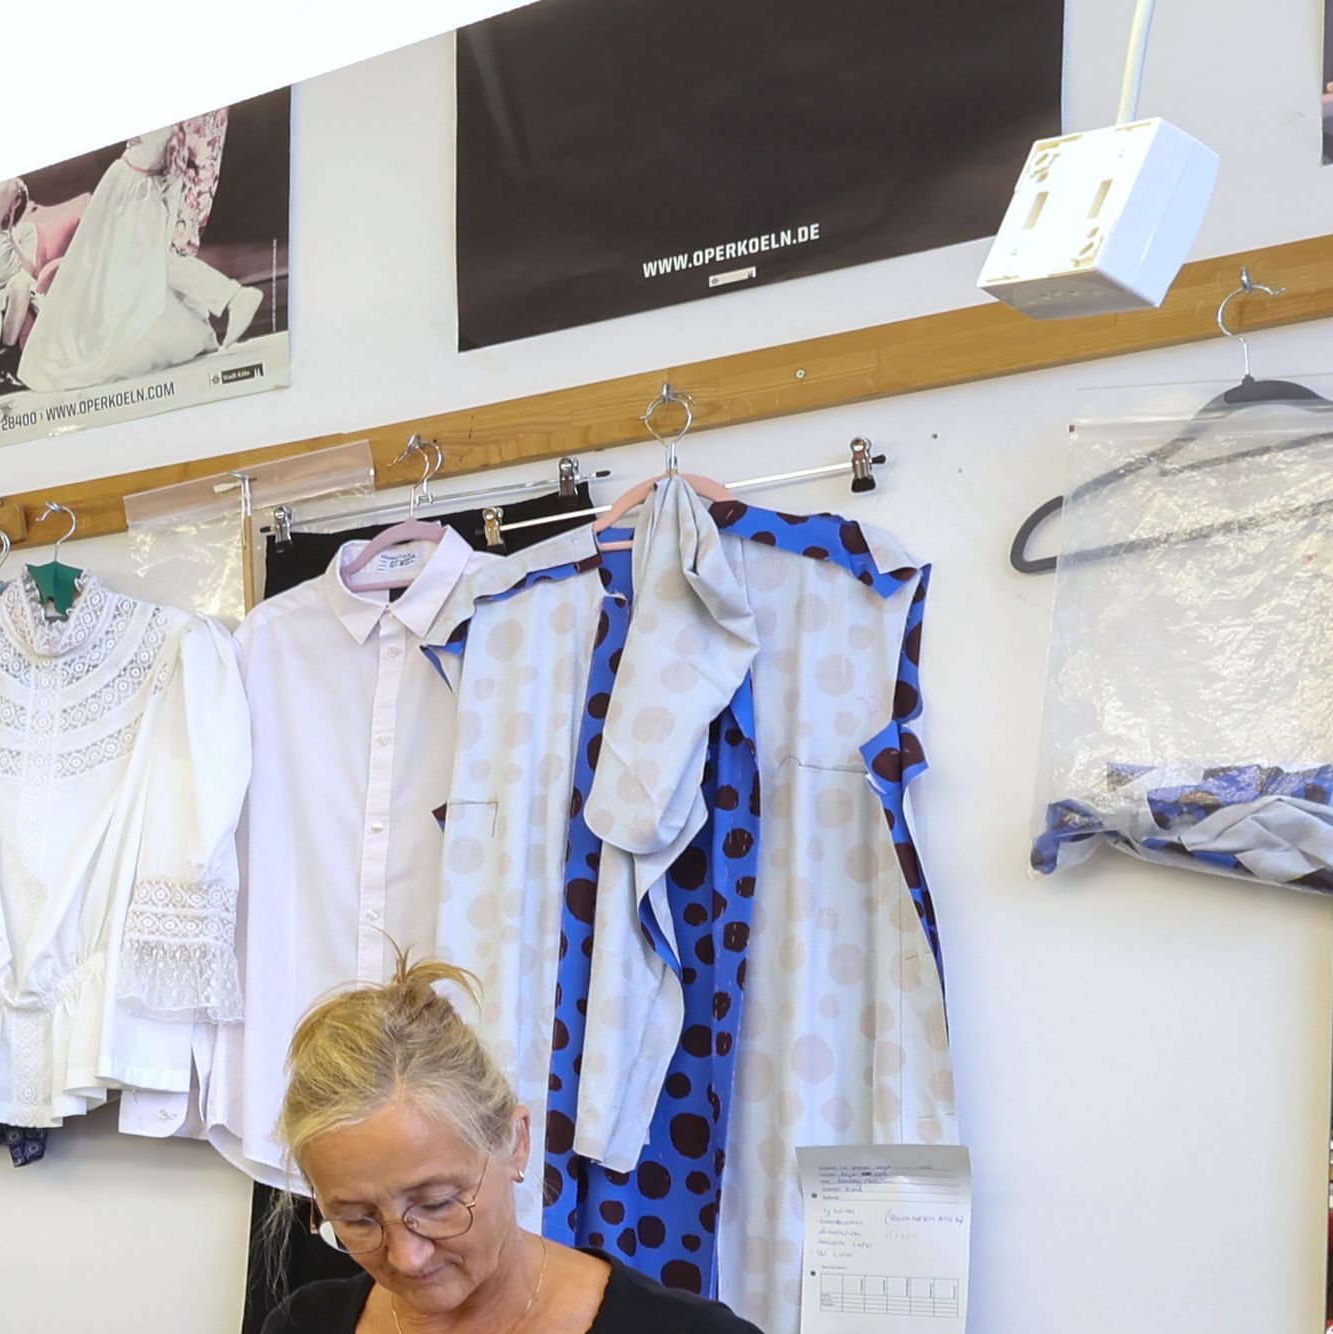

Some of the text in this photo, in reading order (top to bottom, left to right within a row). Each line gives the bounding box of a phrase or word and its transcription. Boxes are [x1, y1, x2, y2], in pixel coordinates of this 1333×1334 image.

[642, 223, 820, 279] WWW.OPERKOELN.DE
[1, 412, 38, 431] 28400
[45, 381, 176, 422] WWW.OPERKOELN.COM
